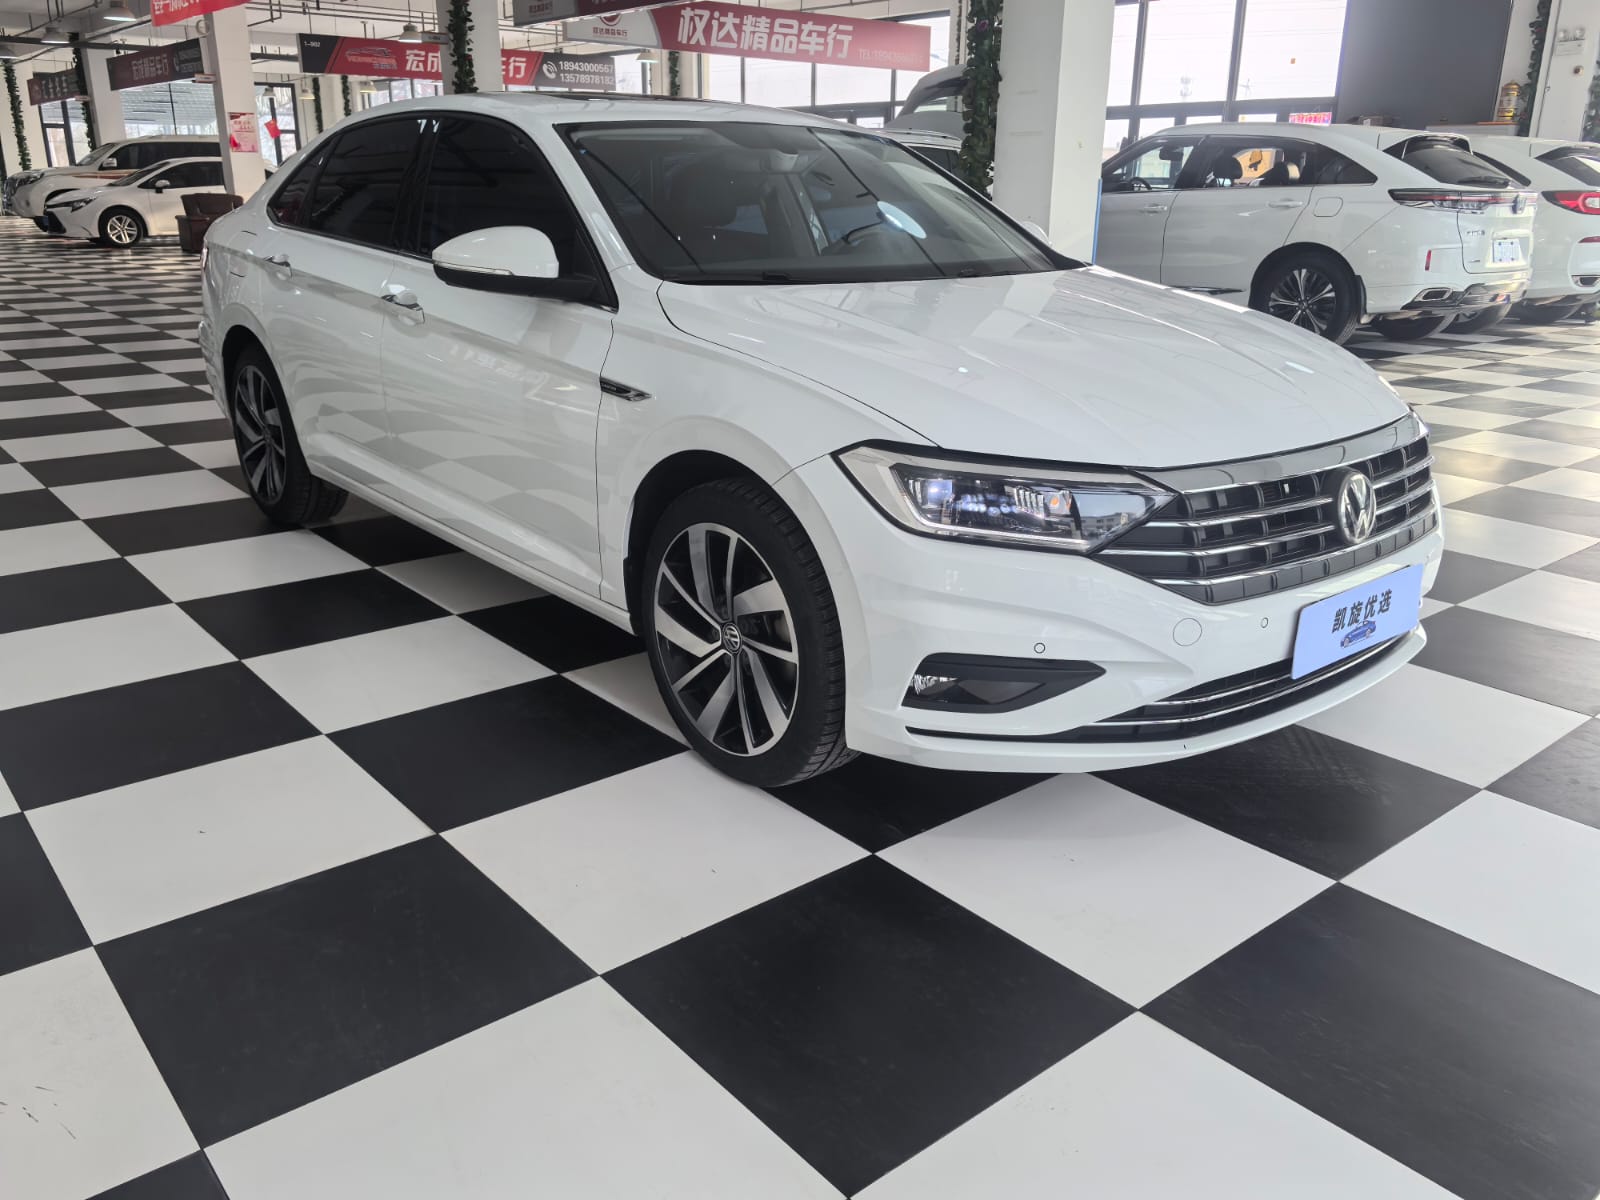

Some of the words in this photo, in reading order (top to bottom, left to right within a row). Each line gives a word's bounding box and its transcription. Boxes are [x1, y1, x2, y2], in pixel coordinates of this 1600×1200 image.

[678, 7, 853, 58] 权达精品车行
[1331, 588, 1393, 633] 凯旋优选
